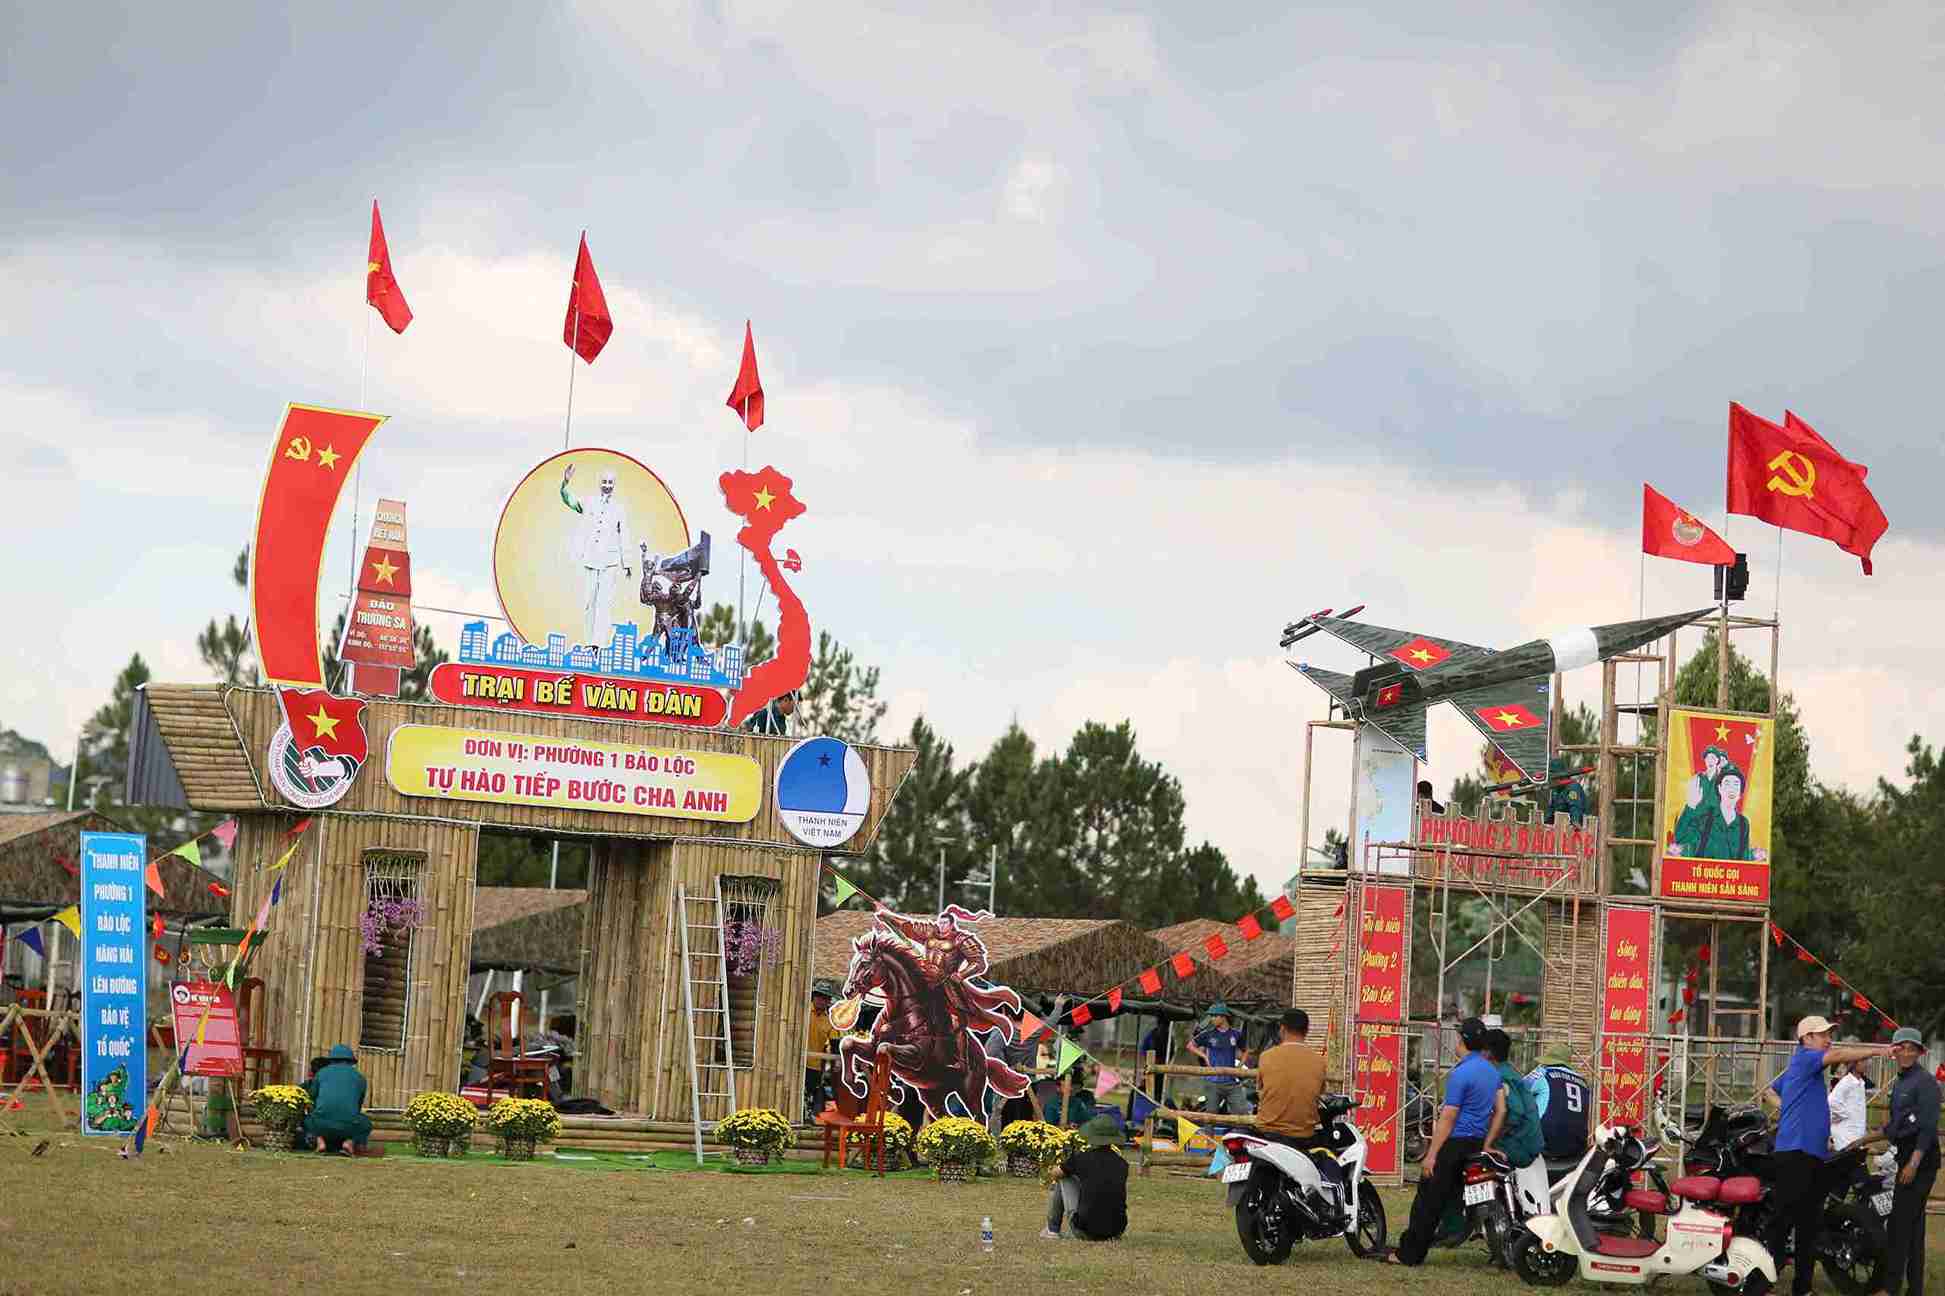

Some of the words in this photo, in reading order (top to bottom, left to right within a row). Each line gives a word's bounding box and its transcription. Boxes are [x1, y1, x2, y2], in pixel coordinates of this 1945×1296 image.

[463, 673, 526, 703] TRẠI
[538, 673, 576, 705] BẾ
[583, 682, 638, 712] VĂN
[645, 687, 702, 718] ĐÀN
[465, 738, 501, 758] ĐƠN
[508, 742, 528, 763] VỊ:
[533, 744, 604, 768] PHƯỜNG
[610, 752, 618, 768] 1
[625, 750, 658, 773] BẢO
[663, 752, 695, 777] LỘC
[426, 766, 456, 795] TỰ
[461, 769, 506, 794] HÀO
[513, 771, 560, 798] TIẾP
[568, 777, 626, 802] BƯỚC
[634, 786, 677, 809] CHA
[683, 790, 728, 813] ANH
[798, 815, 826, 825] THANH
[823, 829, 842, 839] NAM
[1503, 826, 1512, 849] 2
[120, 851, 140, 871] NIÊN
[94, 881, 128, 902] PHƯỜNG
[1672, 880, 1697, 892] THANH
[96, 911, 114, 932] BẢO
[115, 914, 130, 936] LỘC
[92, 974, 109, 994] LÊN
[109, 976, 137, 994] ĐƯỜNG
[101, 1003, 118, 1025] BẢO
[119, 1006, 129, 1029] VỆ
[97, 1033, 108, 1056] TỔ
[1565, 1082, 1582, 1113] 9
